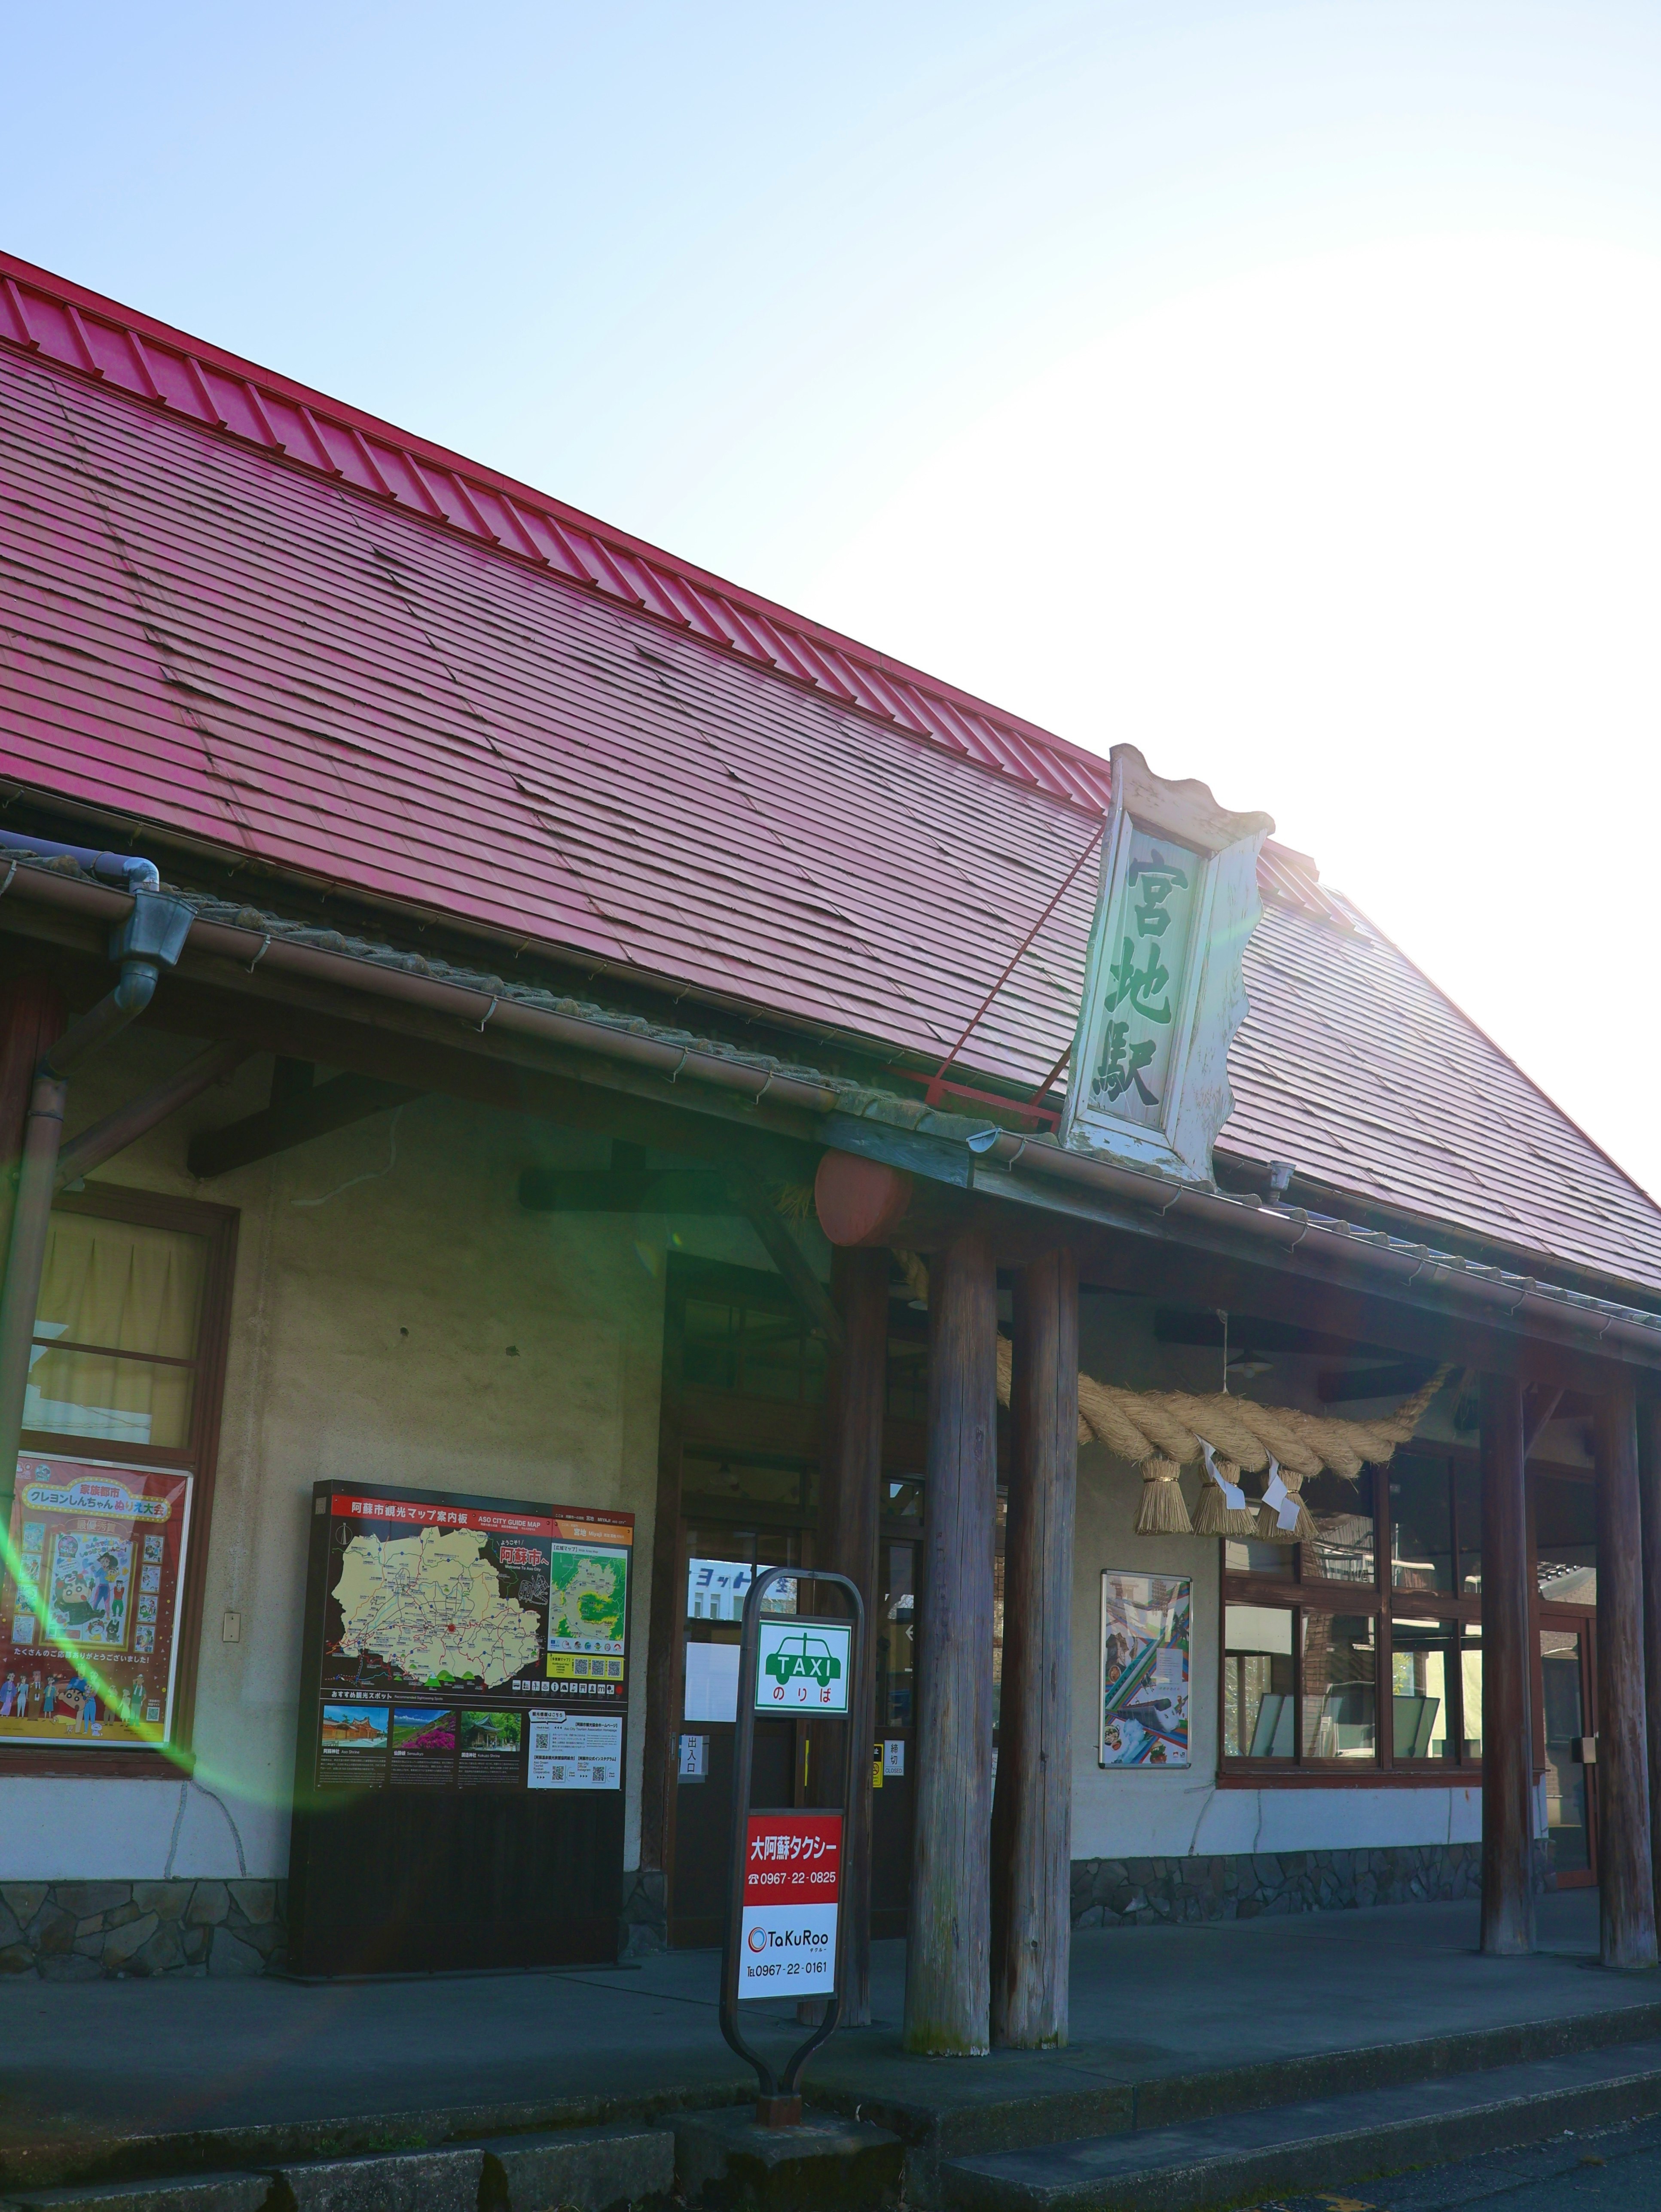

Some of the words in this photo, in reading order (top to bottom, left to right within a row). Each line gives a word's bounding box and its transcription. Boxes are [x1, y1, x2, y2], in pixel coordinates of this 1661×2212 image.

[1093, 849, 1188, 1106] 宮地駅
[80, 1484, 120, 1498] 家族都市
[351, 1502, 468, 1524] 阿蘇市観光マップ案内板
[574, 1528, 586, 1536] 宮地
[500, 1546, 549, 1566] 阿蘇市へ
[689, 1568, 751, 1588] ヨット
[778, 1657, 830, 1676] TAXI
[331, 1691, 392, 1700] おすすめ観光スポット
[773, 1687, 831, 1703] のりば
[687, 1737, 696, 1773] 出入口
[890, 1743, 898, 1764] 締切
[751, 1836, 837, 1861] 大阿蘇タクシー
[760, 1872, 836, 1884] 0967-22-0825
[768, 1930, 828, 1947] TaKuRoo
